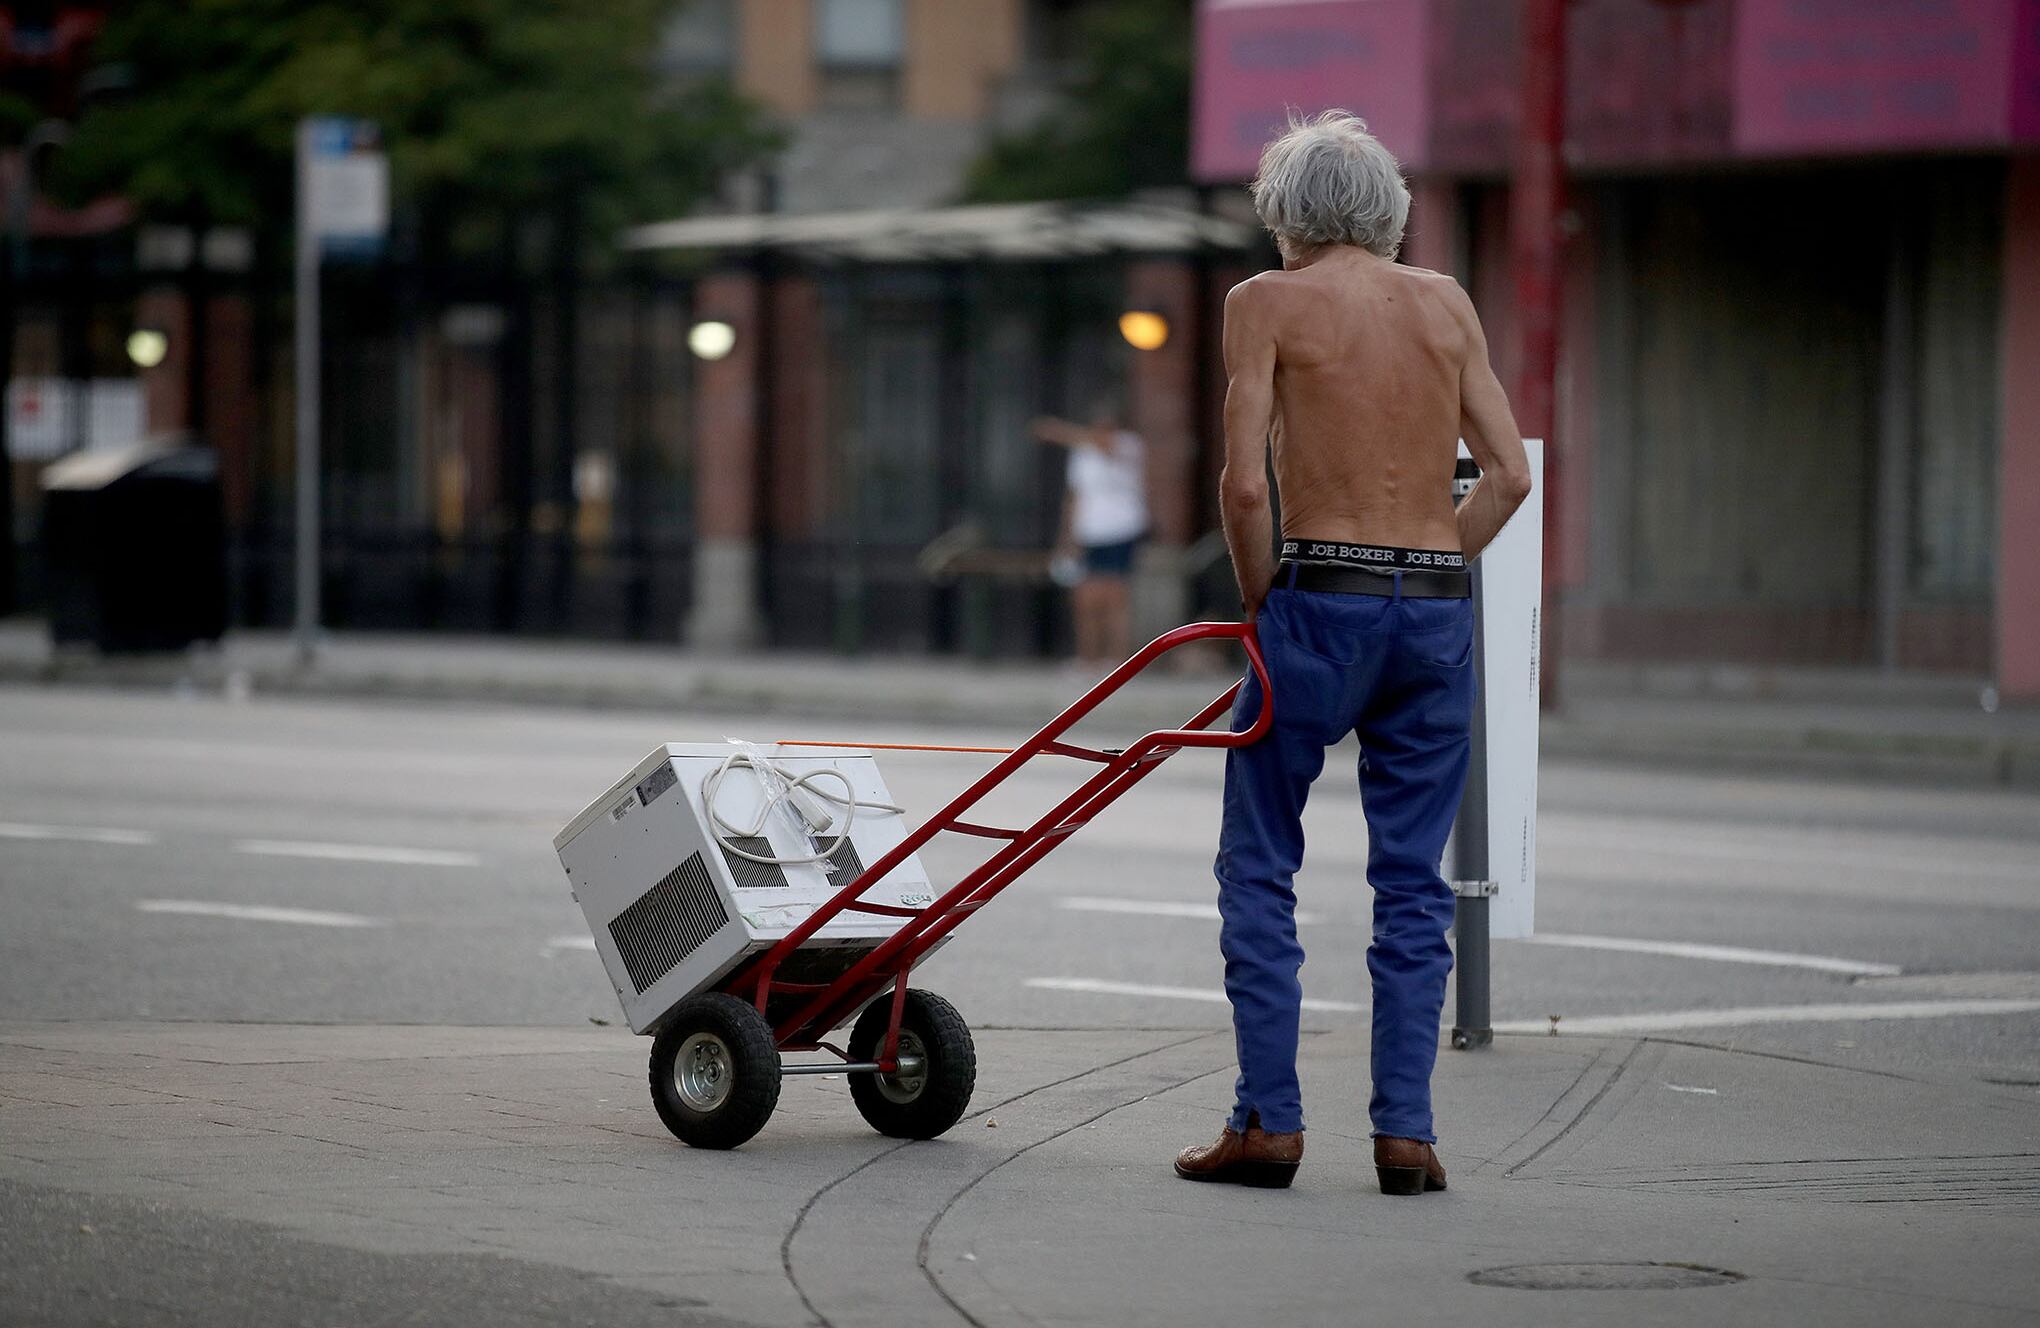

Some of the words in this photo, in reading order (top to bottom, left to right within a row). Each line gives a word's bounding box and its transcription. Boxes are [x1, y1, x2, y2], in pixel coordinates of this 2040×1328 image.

[1308, 543, 1336, 557] JOE
[1337, 546, 1395, 562] BOXER
[1405, 552, 1432, 565] JOE
